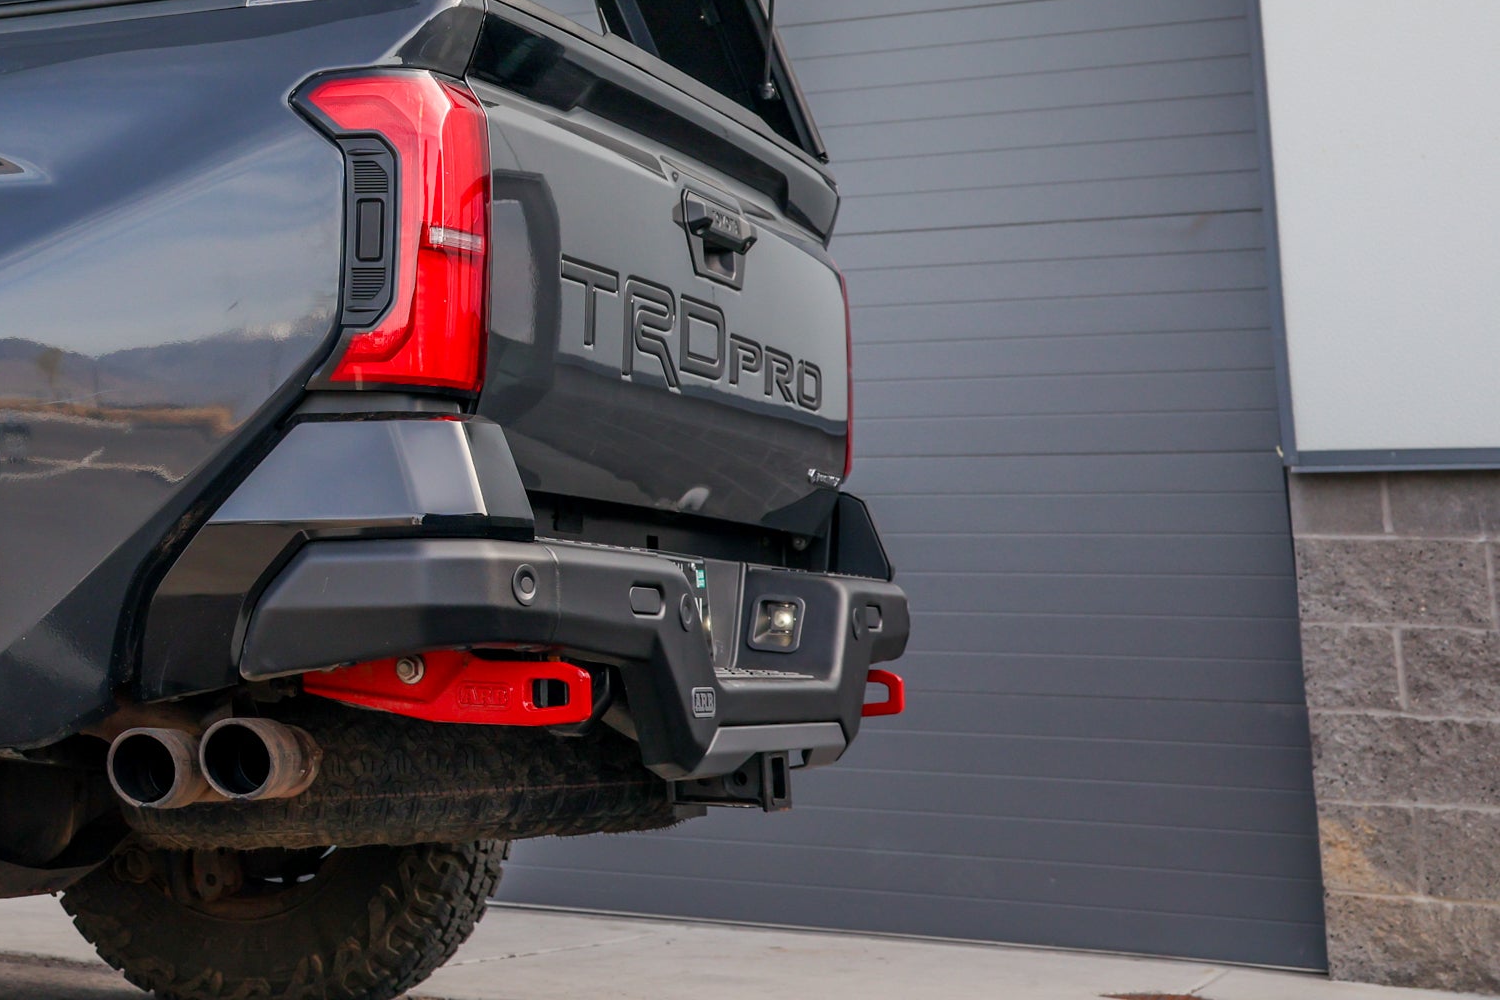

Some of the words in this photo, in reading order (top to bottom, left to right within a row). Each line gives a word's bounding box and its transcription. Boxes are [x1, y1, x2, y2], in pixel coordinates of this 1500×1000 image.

[560, 253, 727, 394] TRD
[728, 332, 823, 413] PRO
[694, 691, 715, 714] ARB
